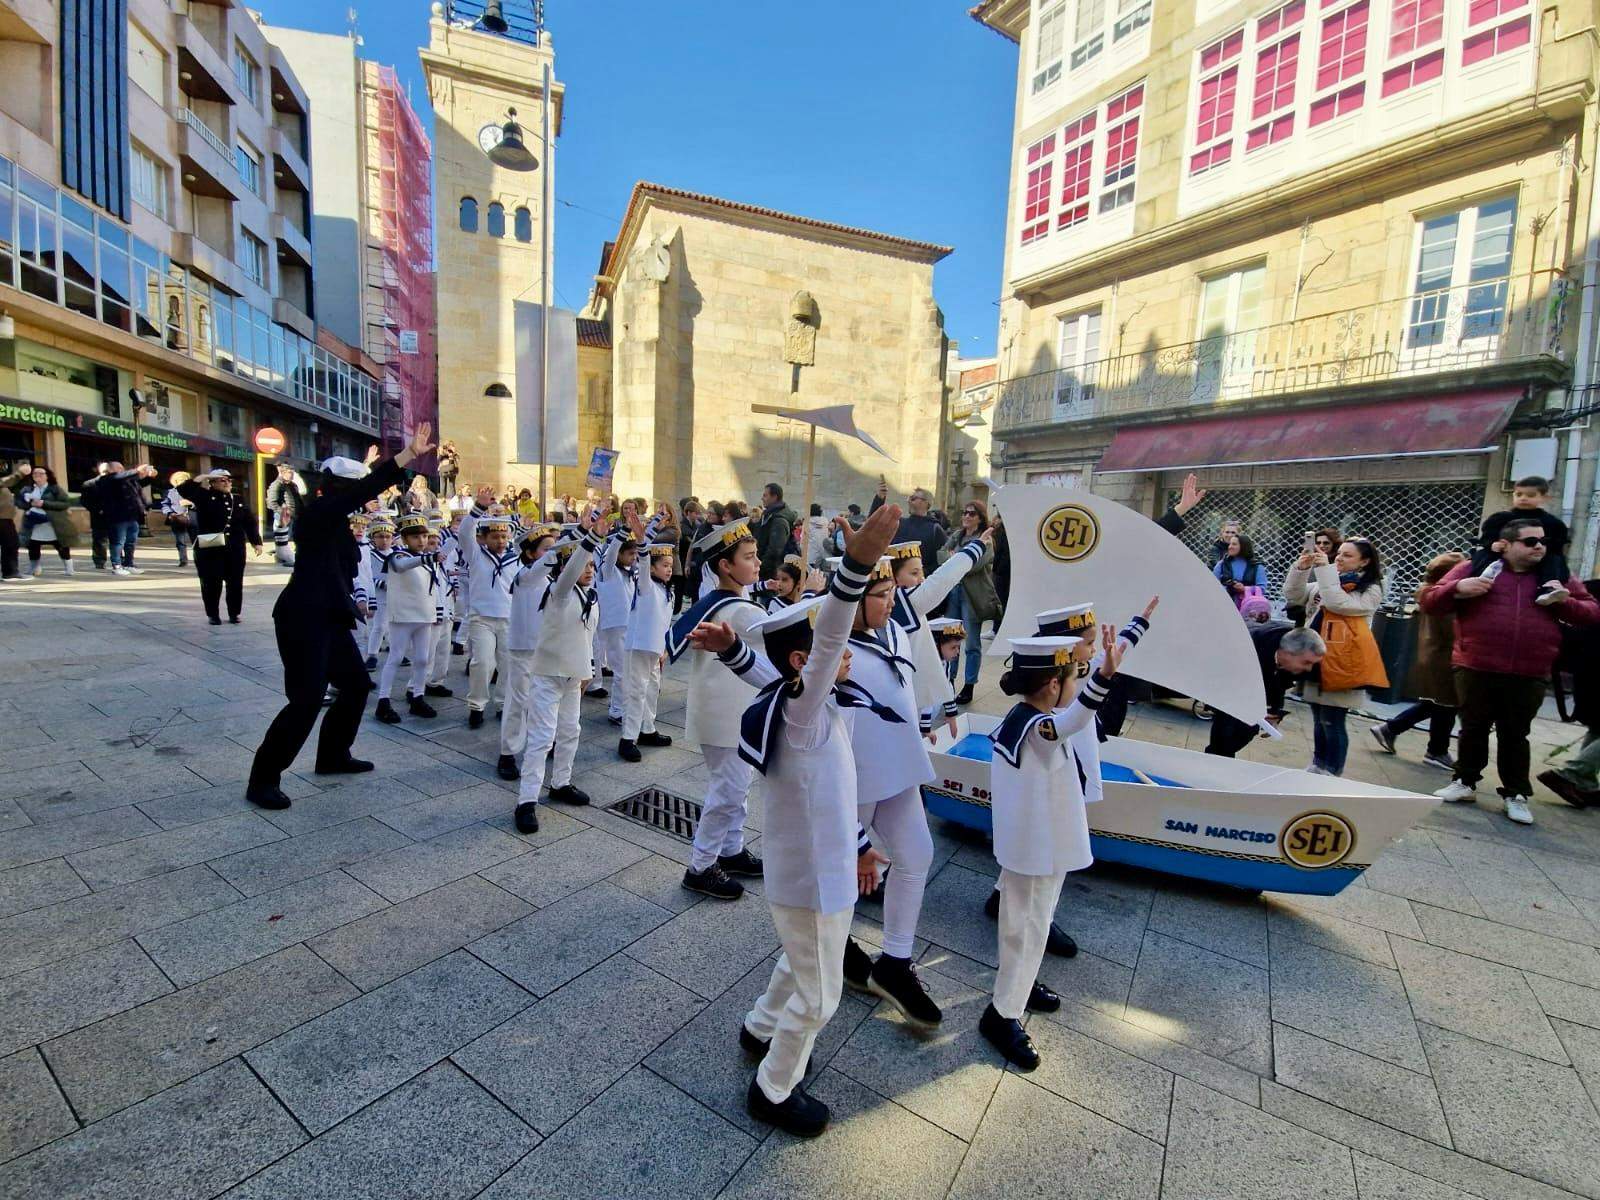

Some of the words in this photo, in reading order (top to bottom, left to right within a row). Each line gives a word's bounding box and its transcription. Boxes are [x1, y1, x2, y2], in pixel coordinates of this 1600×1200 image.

[1046, 517, 1089, 548] SEI
[943, 779, 963, 792] SEI
[1165, 819, 1198, 834] SAN
[1205, 826, 1276, 844] NARCISO
[1290, 823, 1343, 856] SEI
